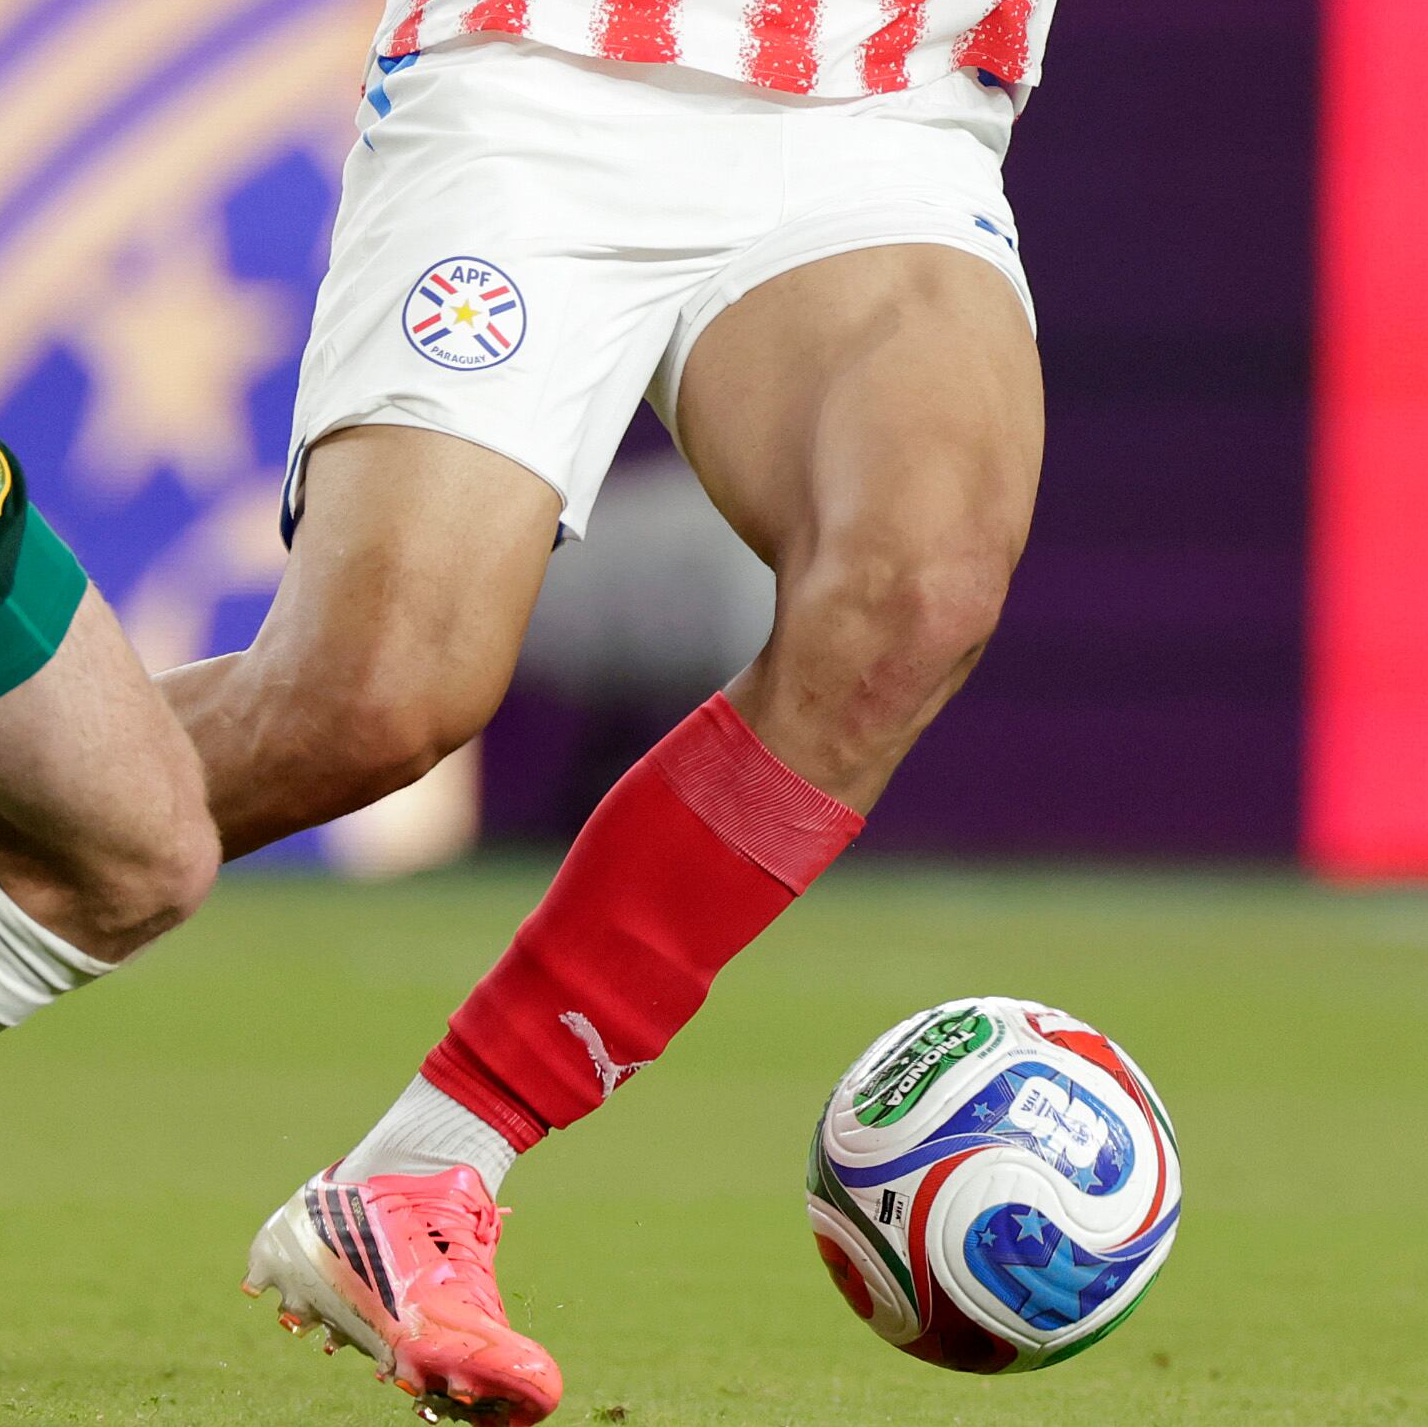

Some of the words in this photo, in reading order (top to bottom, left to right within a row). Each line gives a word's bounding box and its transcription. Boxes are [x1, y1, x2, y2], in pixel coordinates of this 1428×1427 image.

[450, 266, 492, 287] APF
[430, 346, 486, 364] PARAGUAY
[886, 1030, 976, 1106] TRIONDA
[1021, 1089, 1040, 1112] FIFA
[896, 1201, 904, 1220] FIFA
